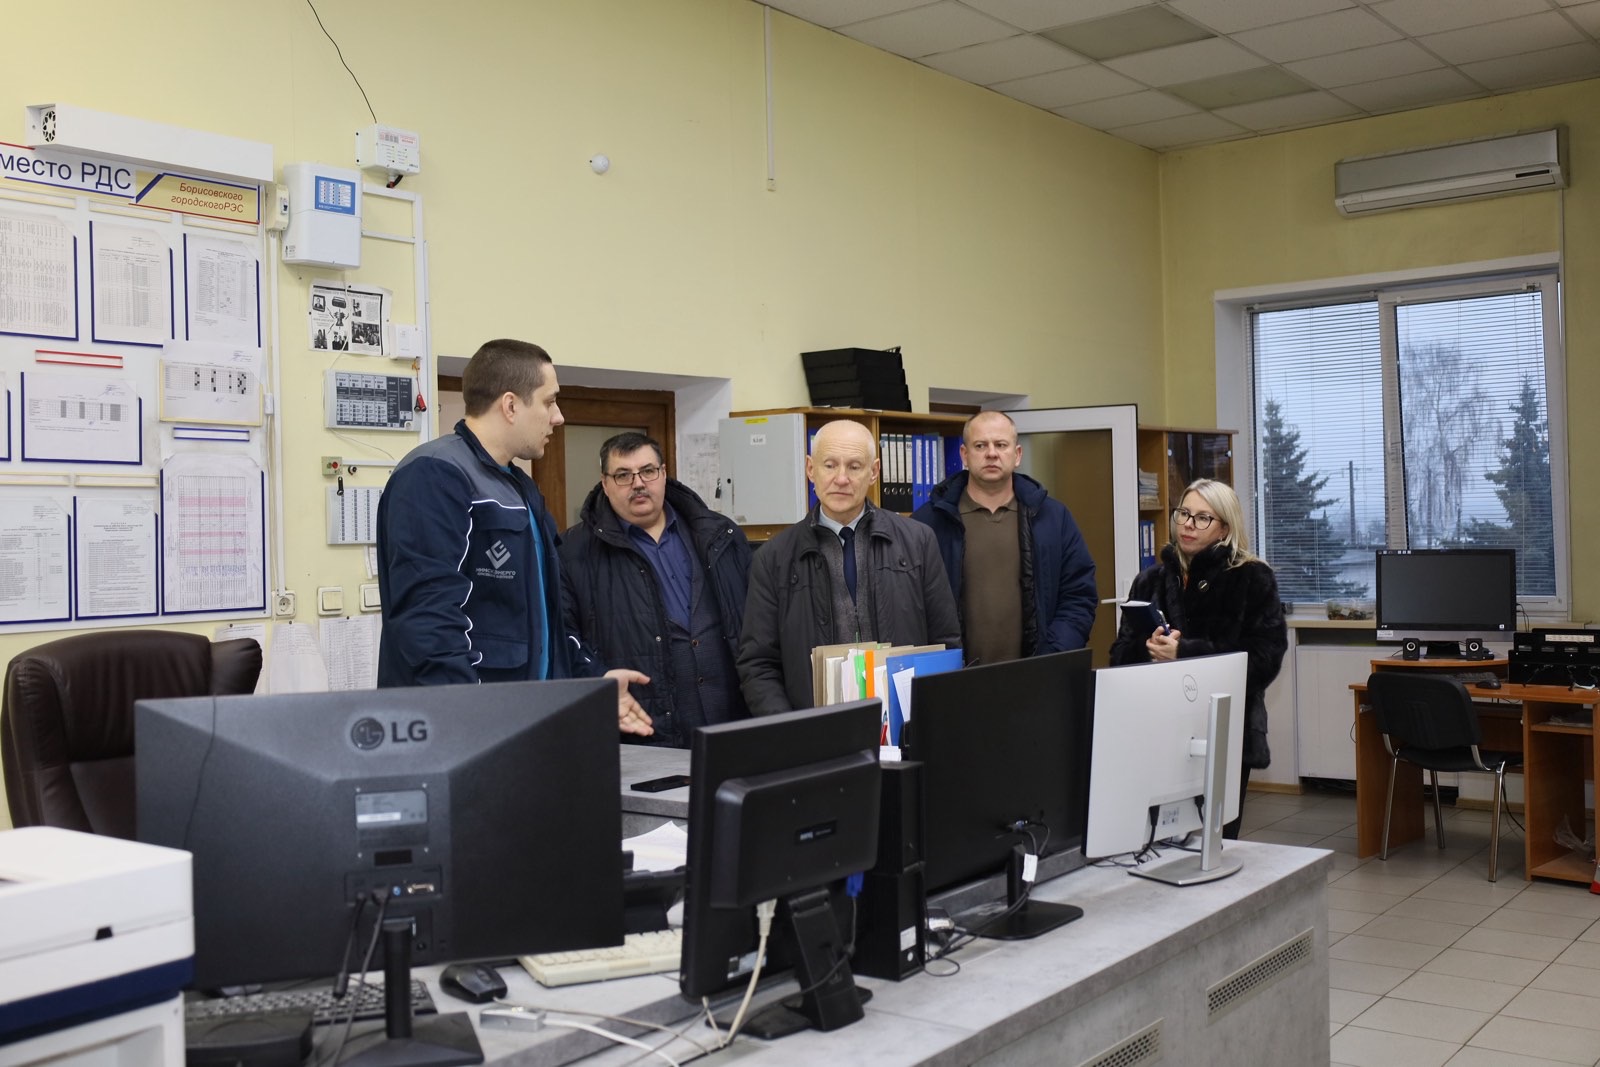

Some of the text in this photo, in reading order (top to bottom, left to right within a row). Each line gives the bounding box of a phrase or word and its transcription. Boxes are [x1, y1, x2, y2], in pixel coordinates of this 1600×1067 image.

[0, 153, 131, 192] место РДС
[179, 182, 243, 201] Борисовского
[391, 720, 428, 743] LG
